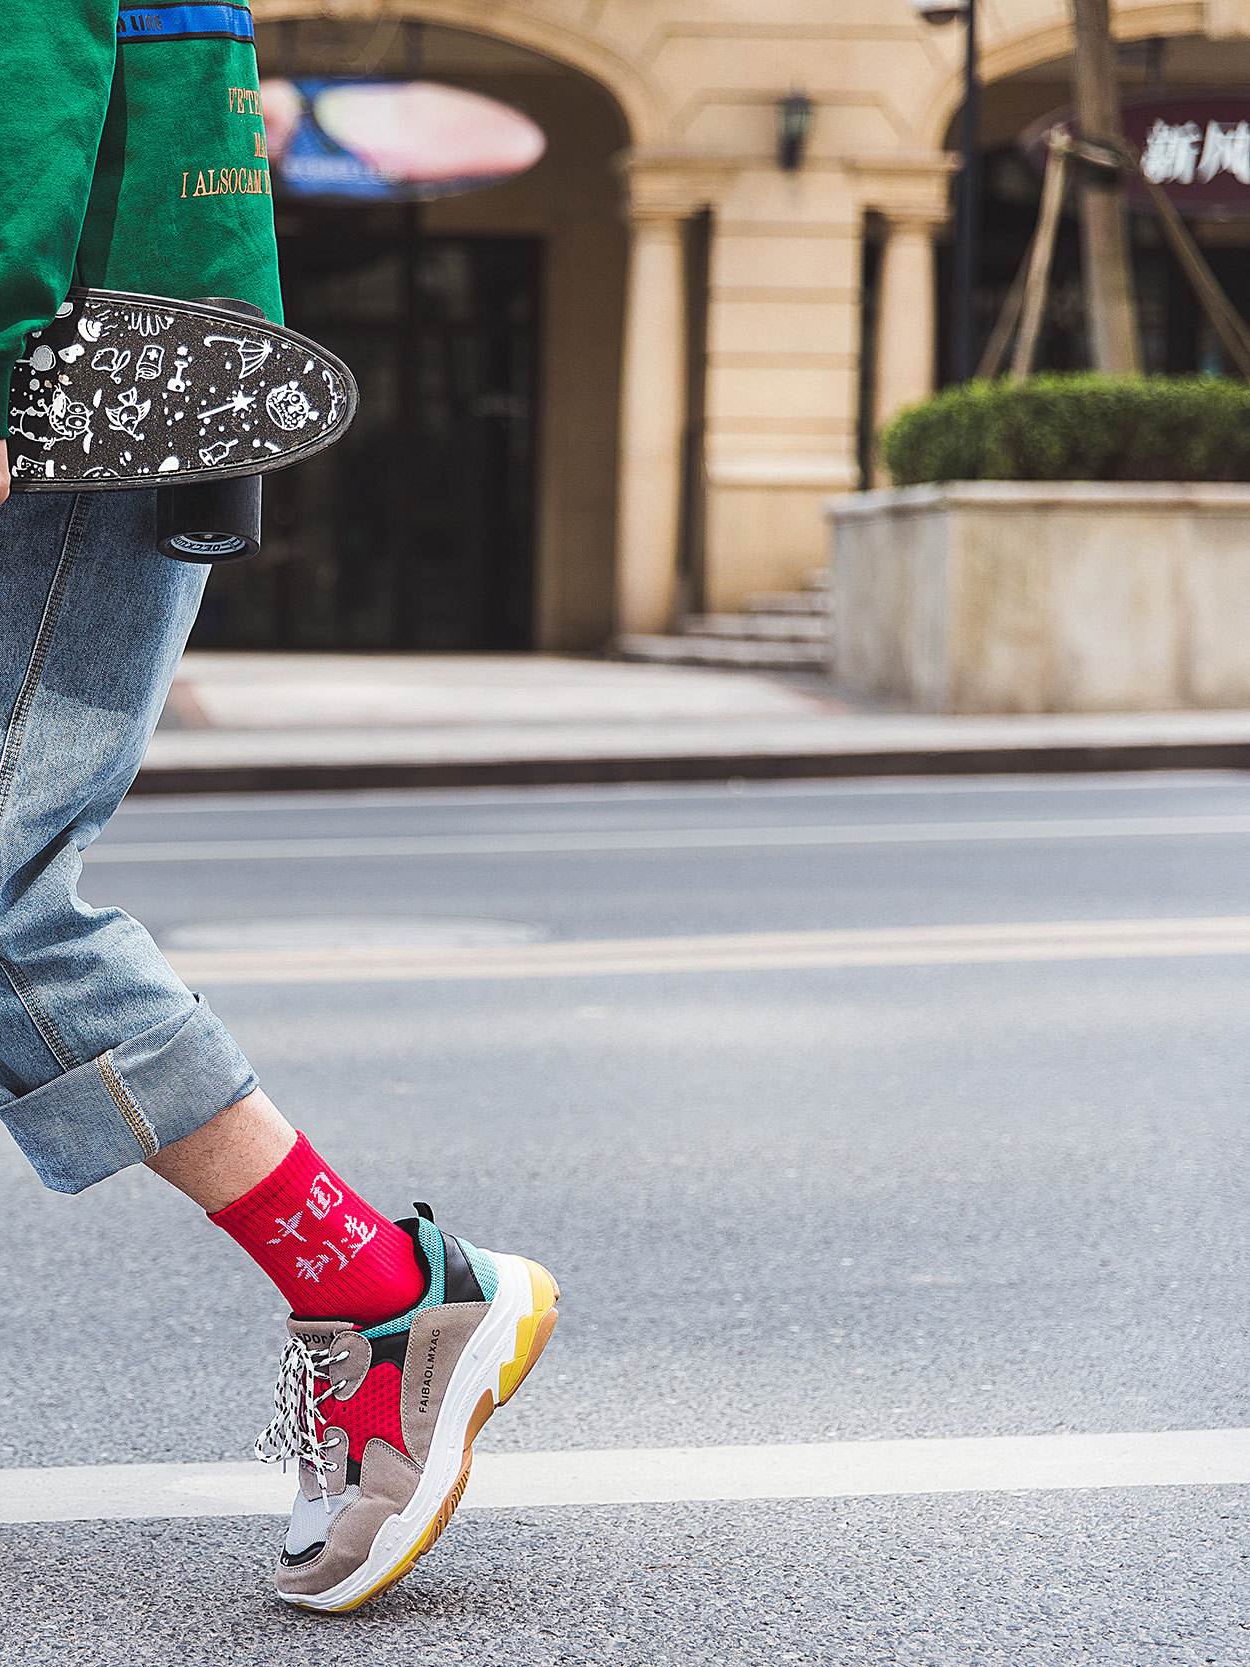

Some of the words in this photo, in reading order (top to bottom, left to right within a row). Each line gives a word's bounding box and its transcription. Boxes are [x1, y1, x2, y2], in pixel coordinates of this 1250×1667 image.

[130, 15, 163, 31] LINE
[265, 1171, 344, 1245] 中国
[294, 1213, 379, 1283] 制造
